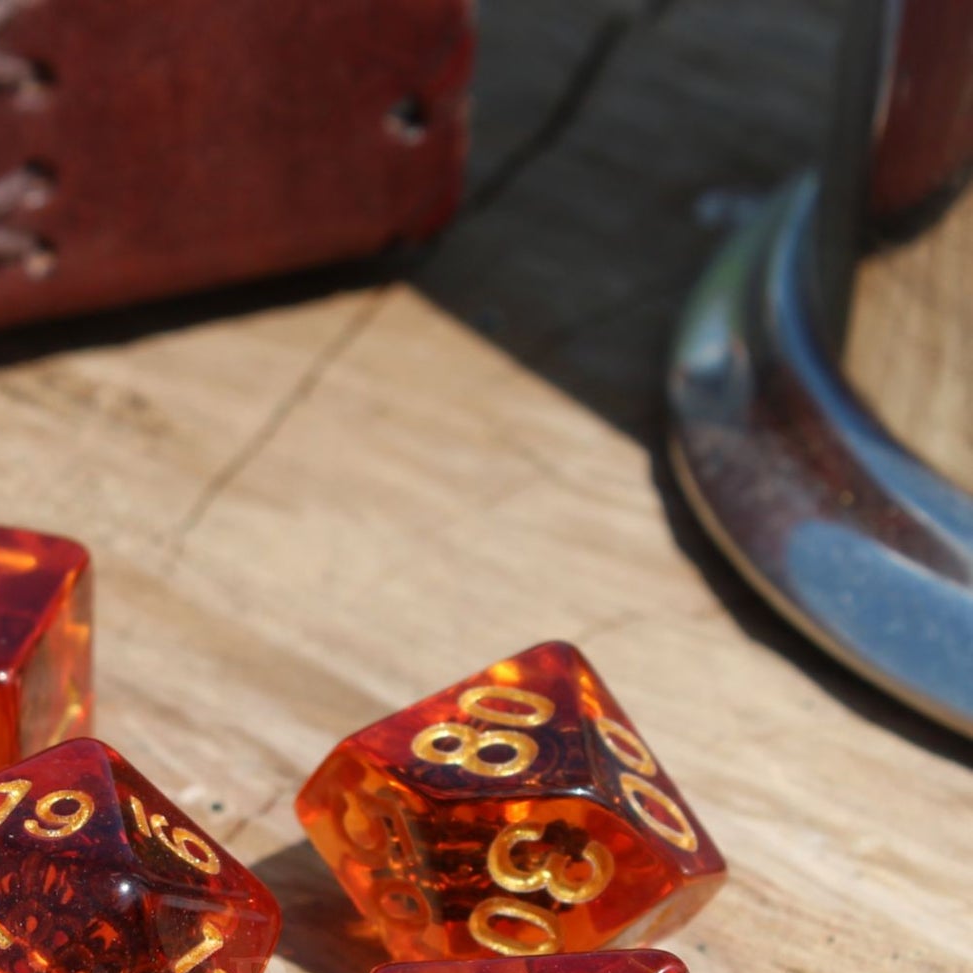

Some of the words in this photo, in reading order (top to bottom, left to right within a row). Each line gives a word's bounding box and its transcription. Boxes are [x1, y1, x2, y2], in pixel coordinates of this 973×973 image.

[411, 685, 555, 777] 80
[596, 717, 698, 853] 00
[129, 796, 221, 875] 16
[468, 821, 615, 956] 30
